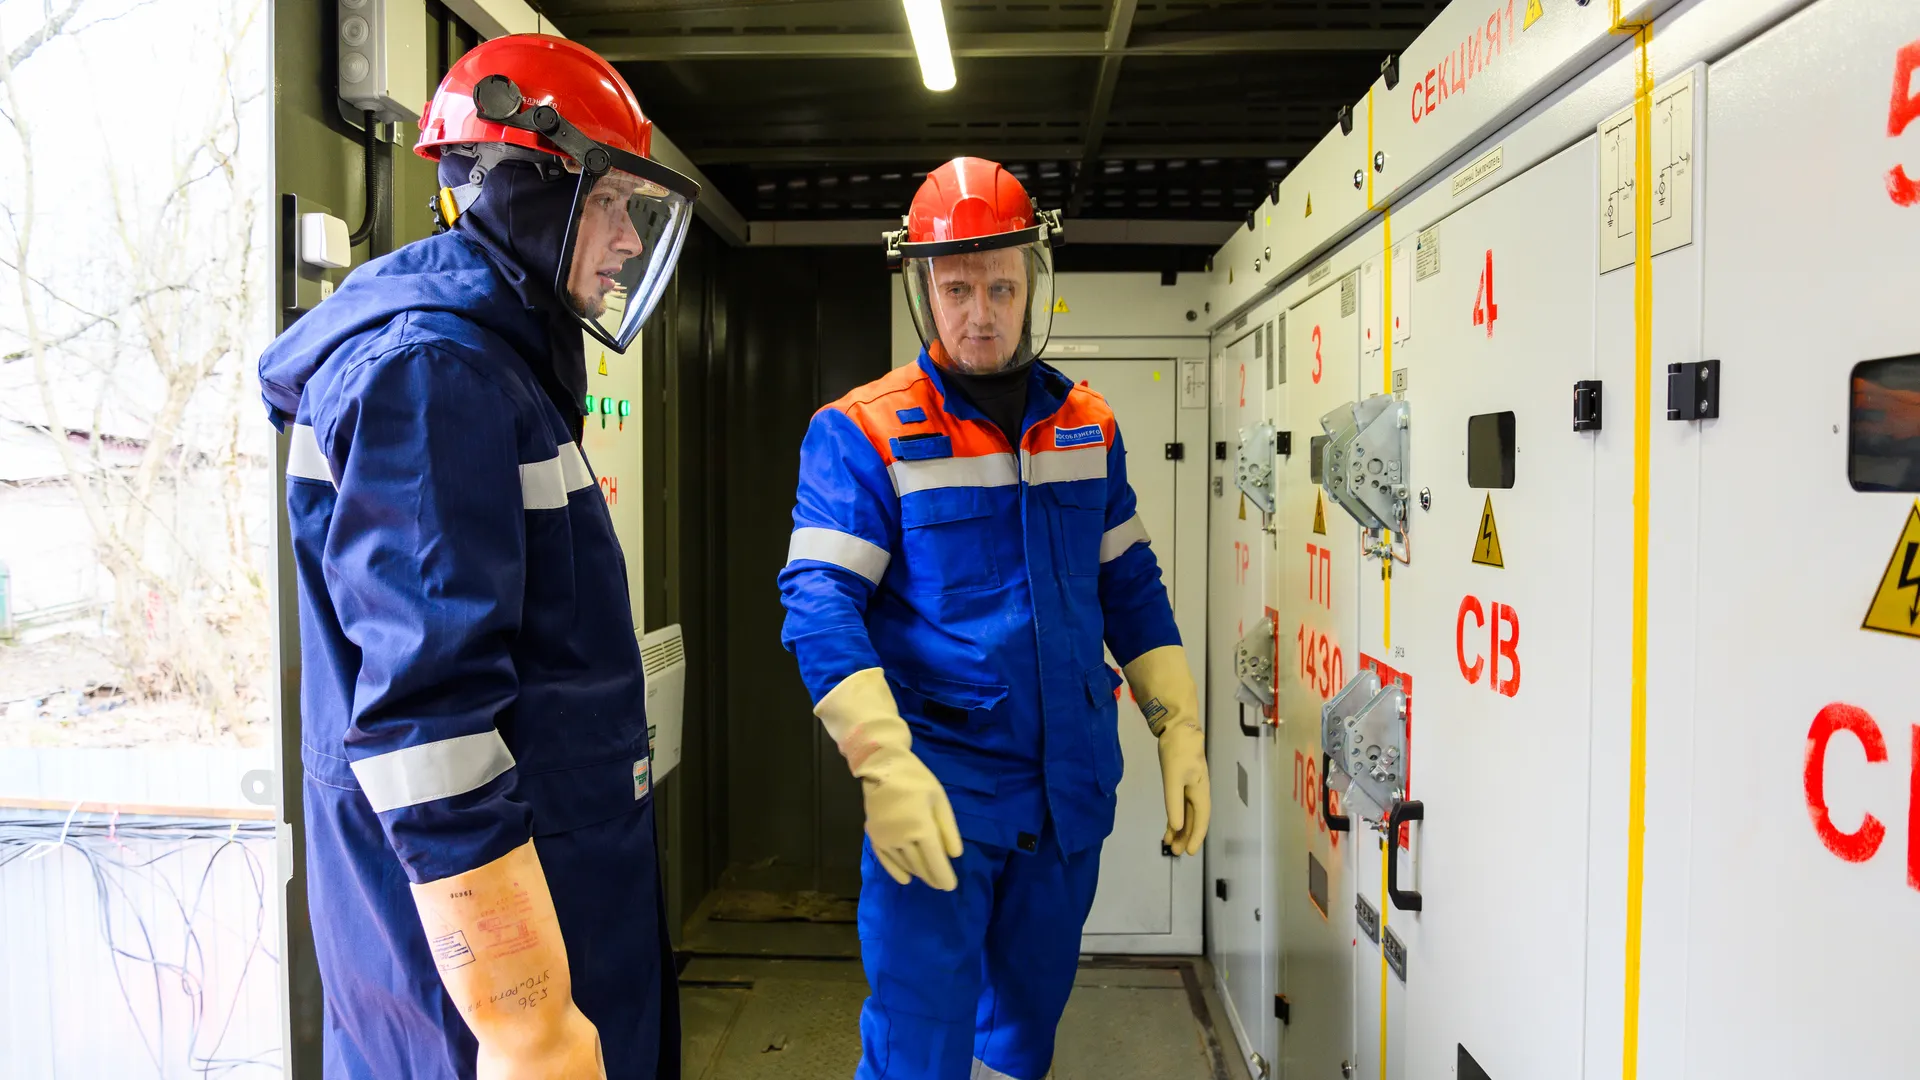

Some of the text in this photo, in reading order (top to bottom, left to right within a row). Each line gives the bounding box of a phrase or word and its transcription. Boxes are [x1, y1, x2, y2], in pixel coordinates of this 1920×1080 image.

[1473, 248, 1498, 338] 4
[1239, 363, 1246, 408] 2
[1312, 324, 1323, 384] 3
[1306, 543, 1331, 610] ТП
[1456, 594, 1521, 698] СВ
[1803, 702, 1920, 894] С
